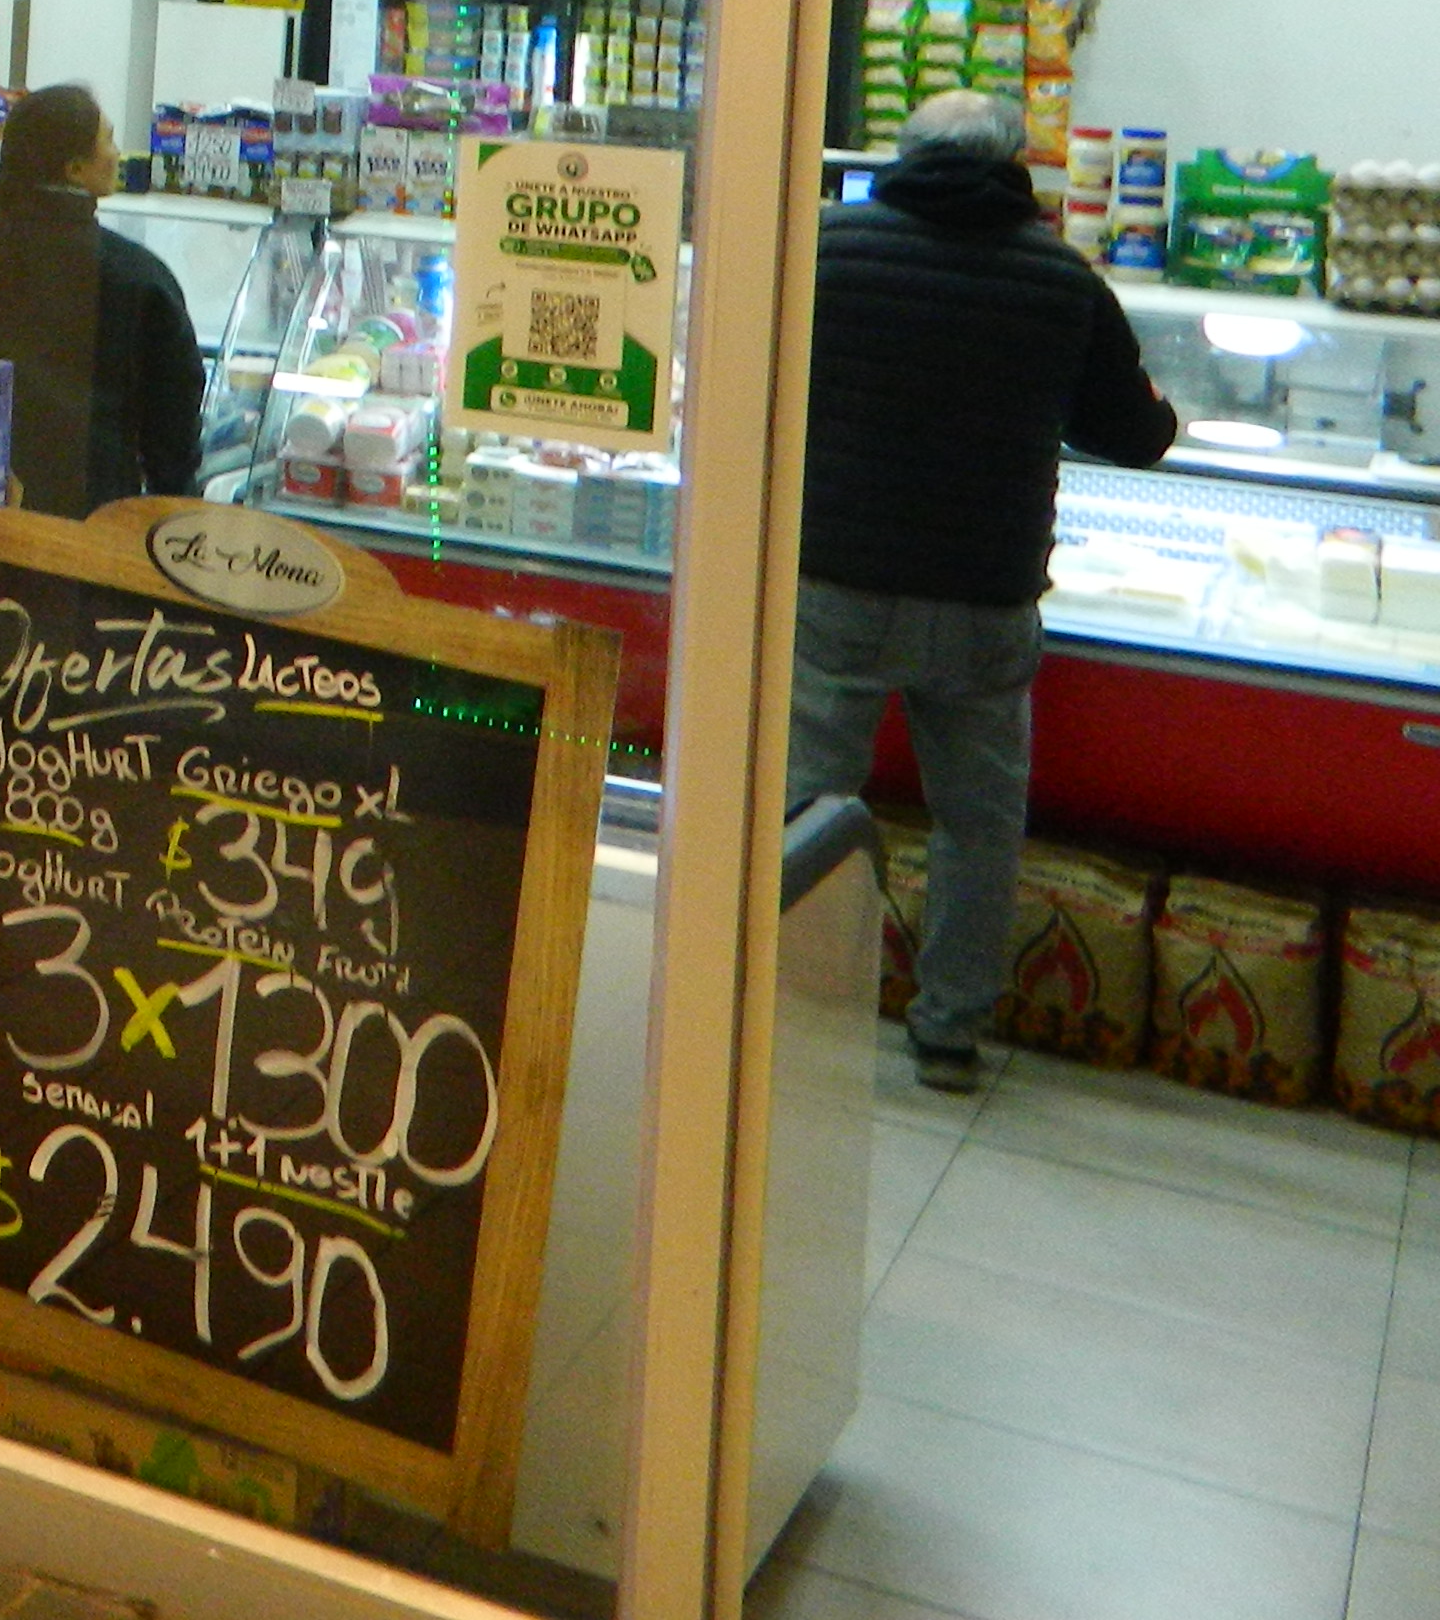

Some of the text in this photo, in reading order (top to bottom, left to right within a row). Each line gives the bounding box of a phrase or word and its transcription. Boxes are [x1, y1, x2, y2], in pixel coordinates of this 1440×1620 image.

[506, 192, 641, 229] GRUPO
[508, 220, 638, 243] DE WHATSAPP
[215, 540, 323, 589] Mona
